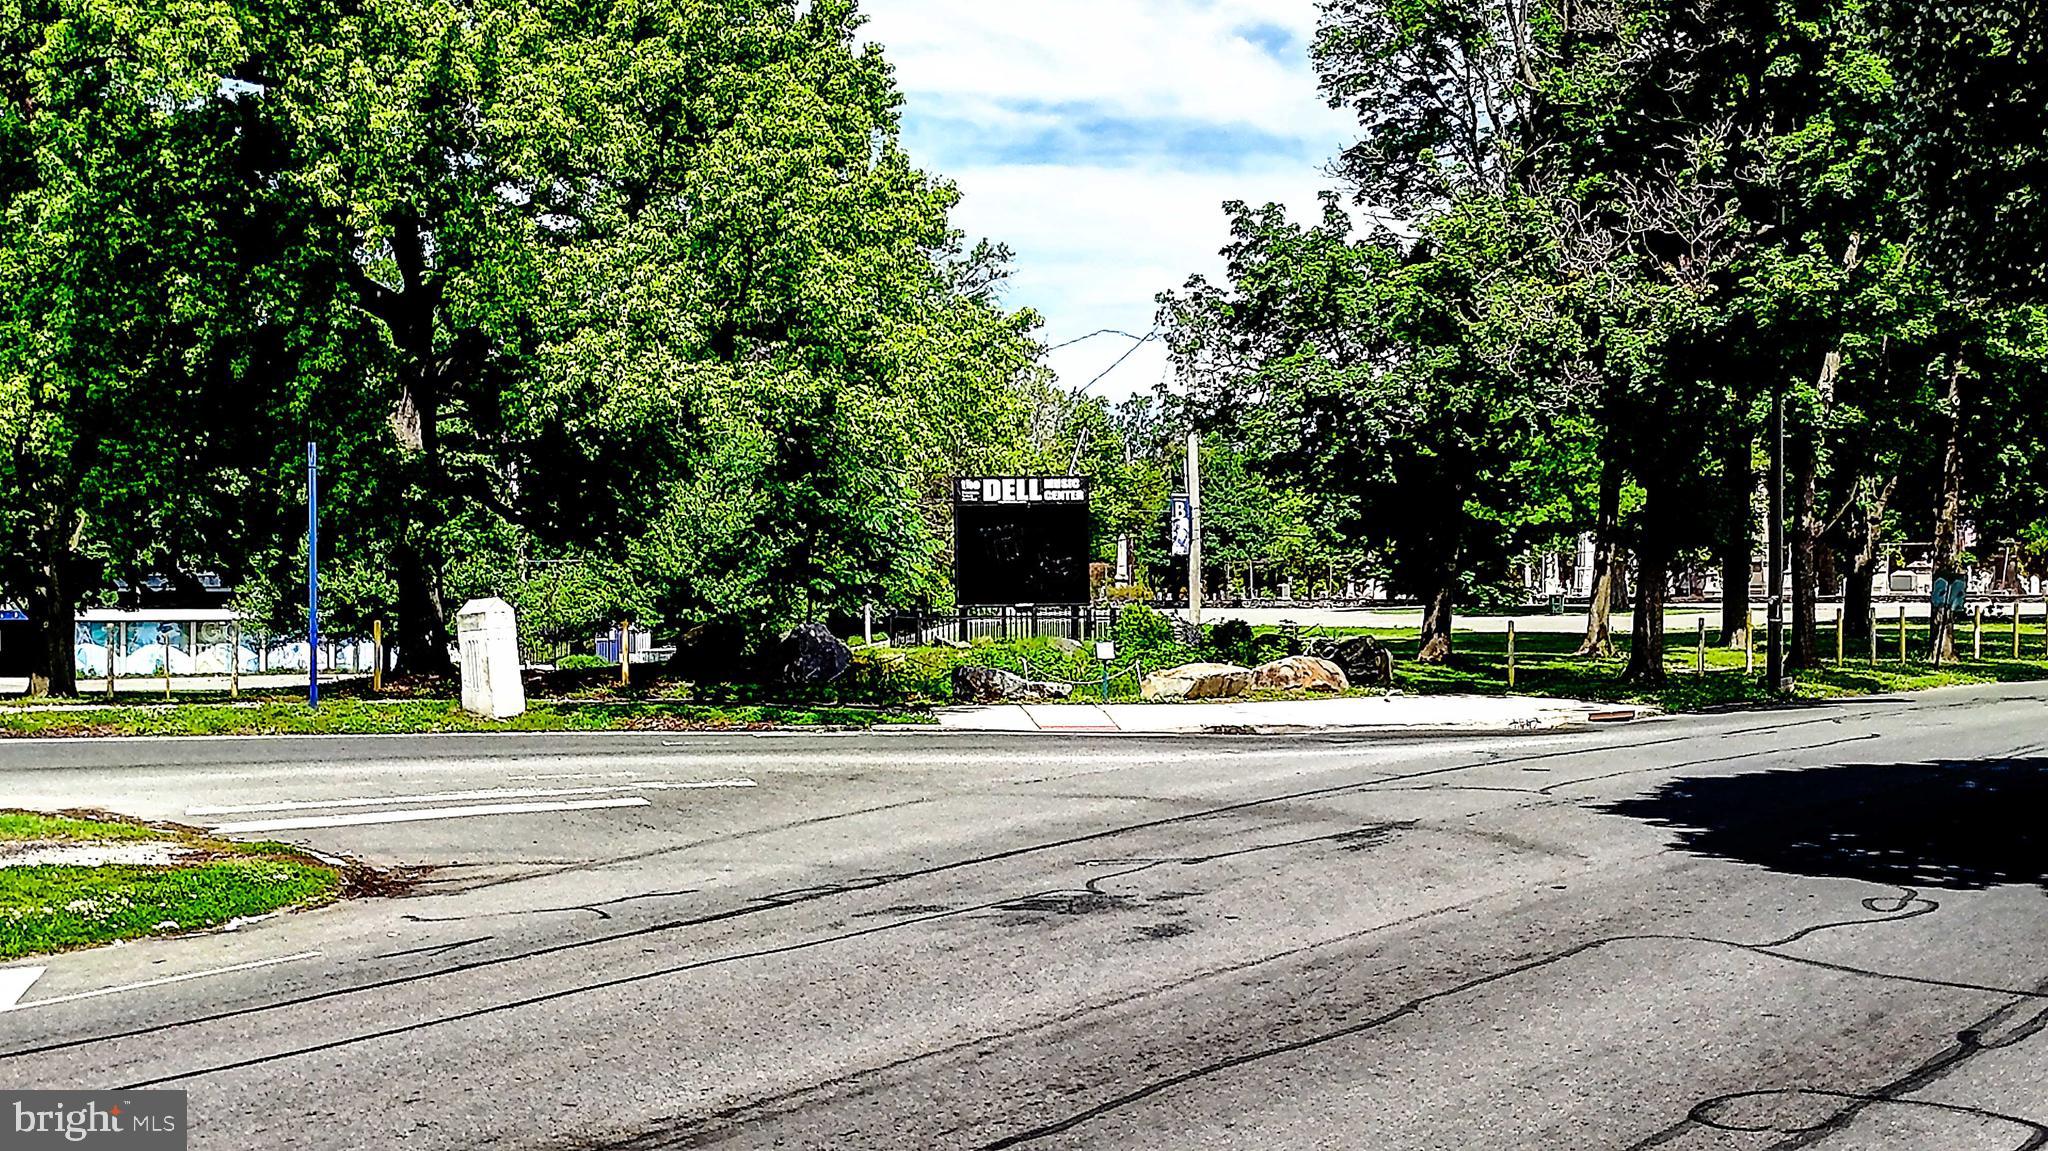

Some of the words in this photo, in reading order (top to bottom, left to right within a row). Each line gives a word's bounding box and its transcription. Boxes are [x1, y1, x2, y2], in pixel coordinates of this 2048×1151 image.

[982, 478, 1042, 501] DELL
[1043, 478, 1080, 489] MUSIC
[1043, 489, 1085, 501] CENTER
